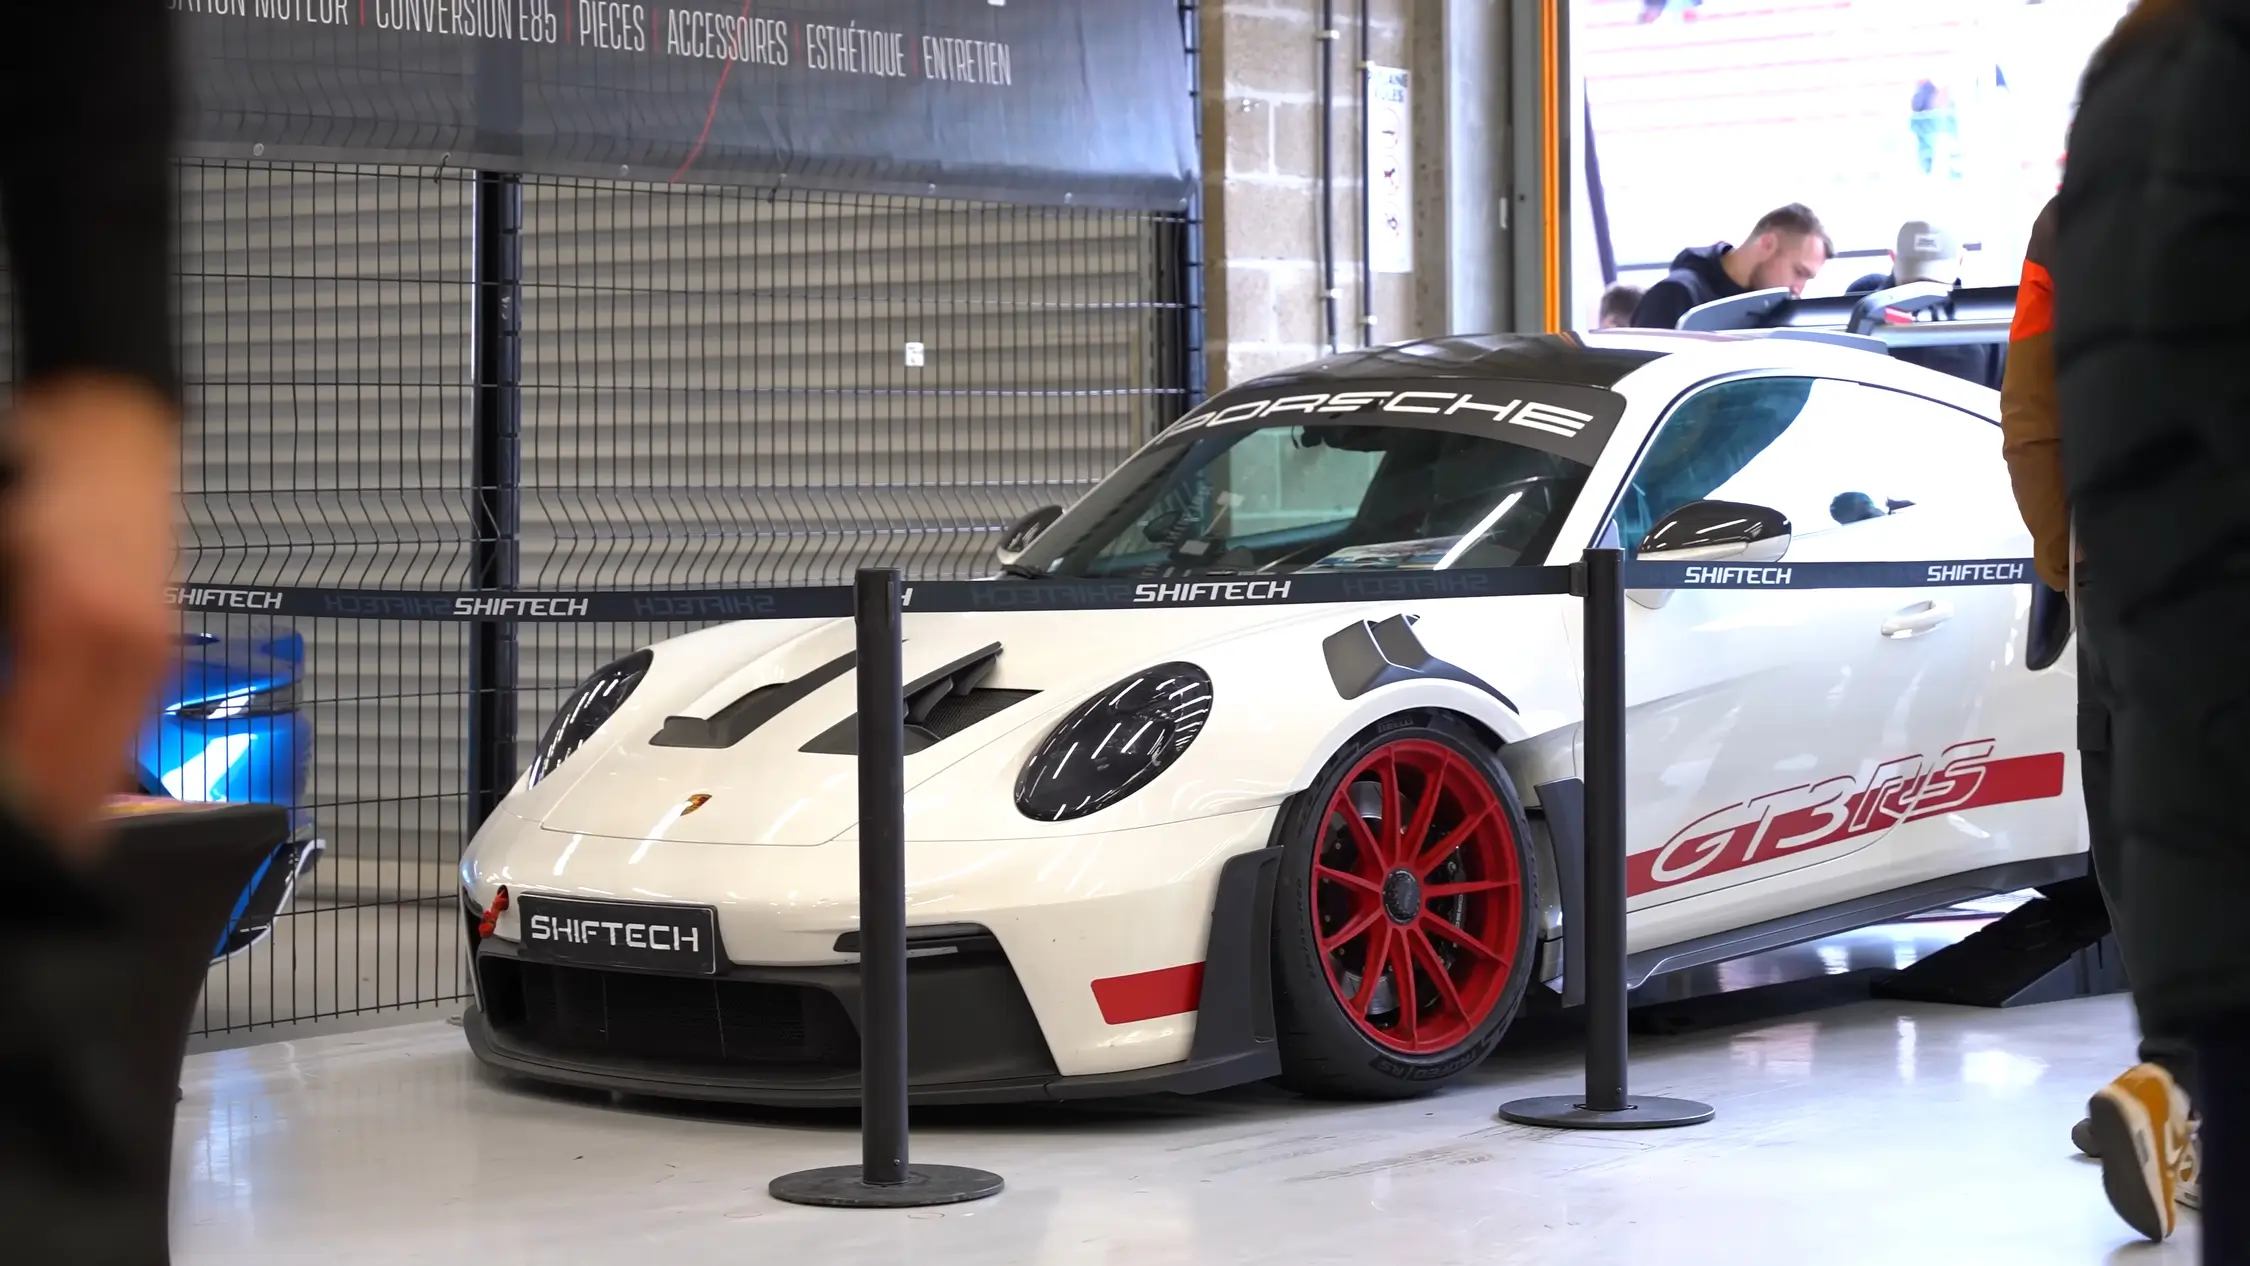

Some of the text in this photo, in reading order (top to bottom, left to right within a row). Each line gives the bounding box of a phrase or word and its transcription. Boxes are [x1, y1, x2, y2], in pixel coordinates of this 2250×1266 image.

[519, 0, 557, 43] E85
[667, 9, 789, 66] ACCESSOIRES
[806, 19, 906, 77] ESTHÉTIQUE
[922, 36, 1012, 86] ENTRETIEN
[1155, 391, 1594, 445] PORSCHE
[1684, 566, 1792, 585] SHIFTECH
[1927, 563, 2023, 582] SHIFTECH
[162, 587, 283, 610] SHIFTECH
[1133, 580, 1292, 602] SHIFTECH
[453, 596, 589, 616] SHIFTECH
[531, 914, 699, 953] SHIFTECH
